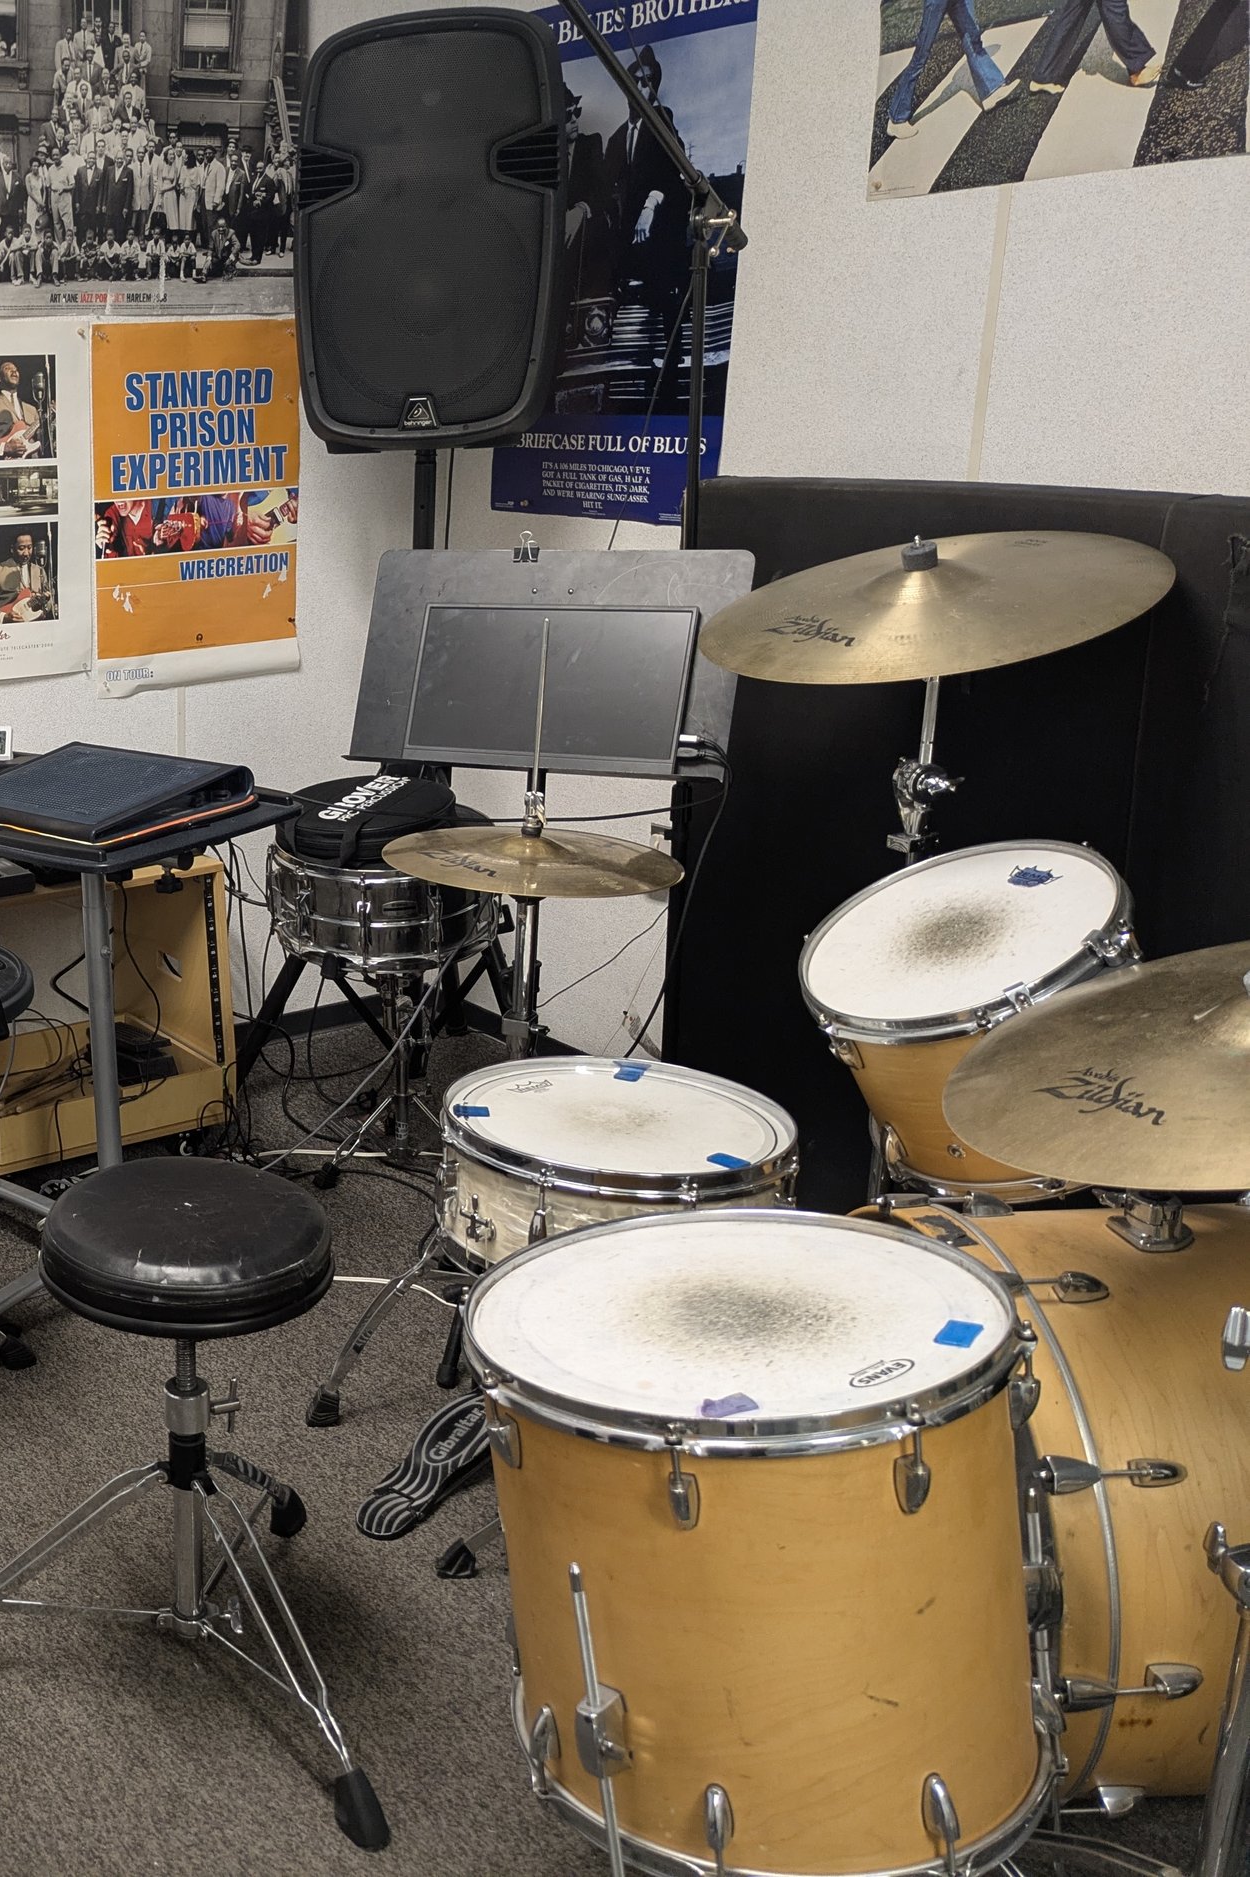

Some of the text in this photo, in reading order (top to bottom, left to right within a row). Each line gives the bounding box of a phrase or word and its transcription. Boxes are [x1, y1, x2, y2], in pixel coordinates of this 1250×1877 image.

[50, 294, 61, 303] ART
[62, 294, 78, 303] KANE
[80, 292, 93, 303] JAZZ
[127, 293, 151, 303] HARLEM
[125, 368, 273, 412] STANFORD
[149, 408, 255, 450] PRISON
[588, 435, 624, 452] FULL
[628, 435, 650, 453] OF
[653, 437, 706, 455] BLUS
[111, 444, 288, 492] EXPERIMENT
[563, 472, 577, 480] FULL
[609, 475, 623, 483] GAS,
[570, 463, 587, 471] MILES
[597, 464, 628, 474] CHICAGO,
[543, 480, 564, 488] PACKET
[575, 482, 614, 492] CIGARETTES,
[616, 484, 627, 492] IT'S
[576, 491, 605, 500] WEARING
[179, 552, 289, 581] WRECREATION
[762, 618, 855, 646] Zildjian
[106, 668, 154, 682] ON TOUR:
[1031, 1077, 1166, 1125] Zildjian
[858, 1362, 907, 1384] EVANS
[430, 1408, 485, 1459] Gibraltar
